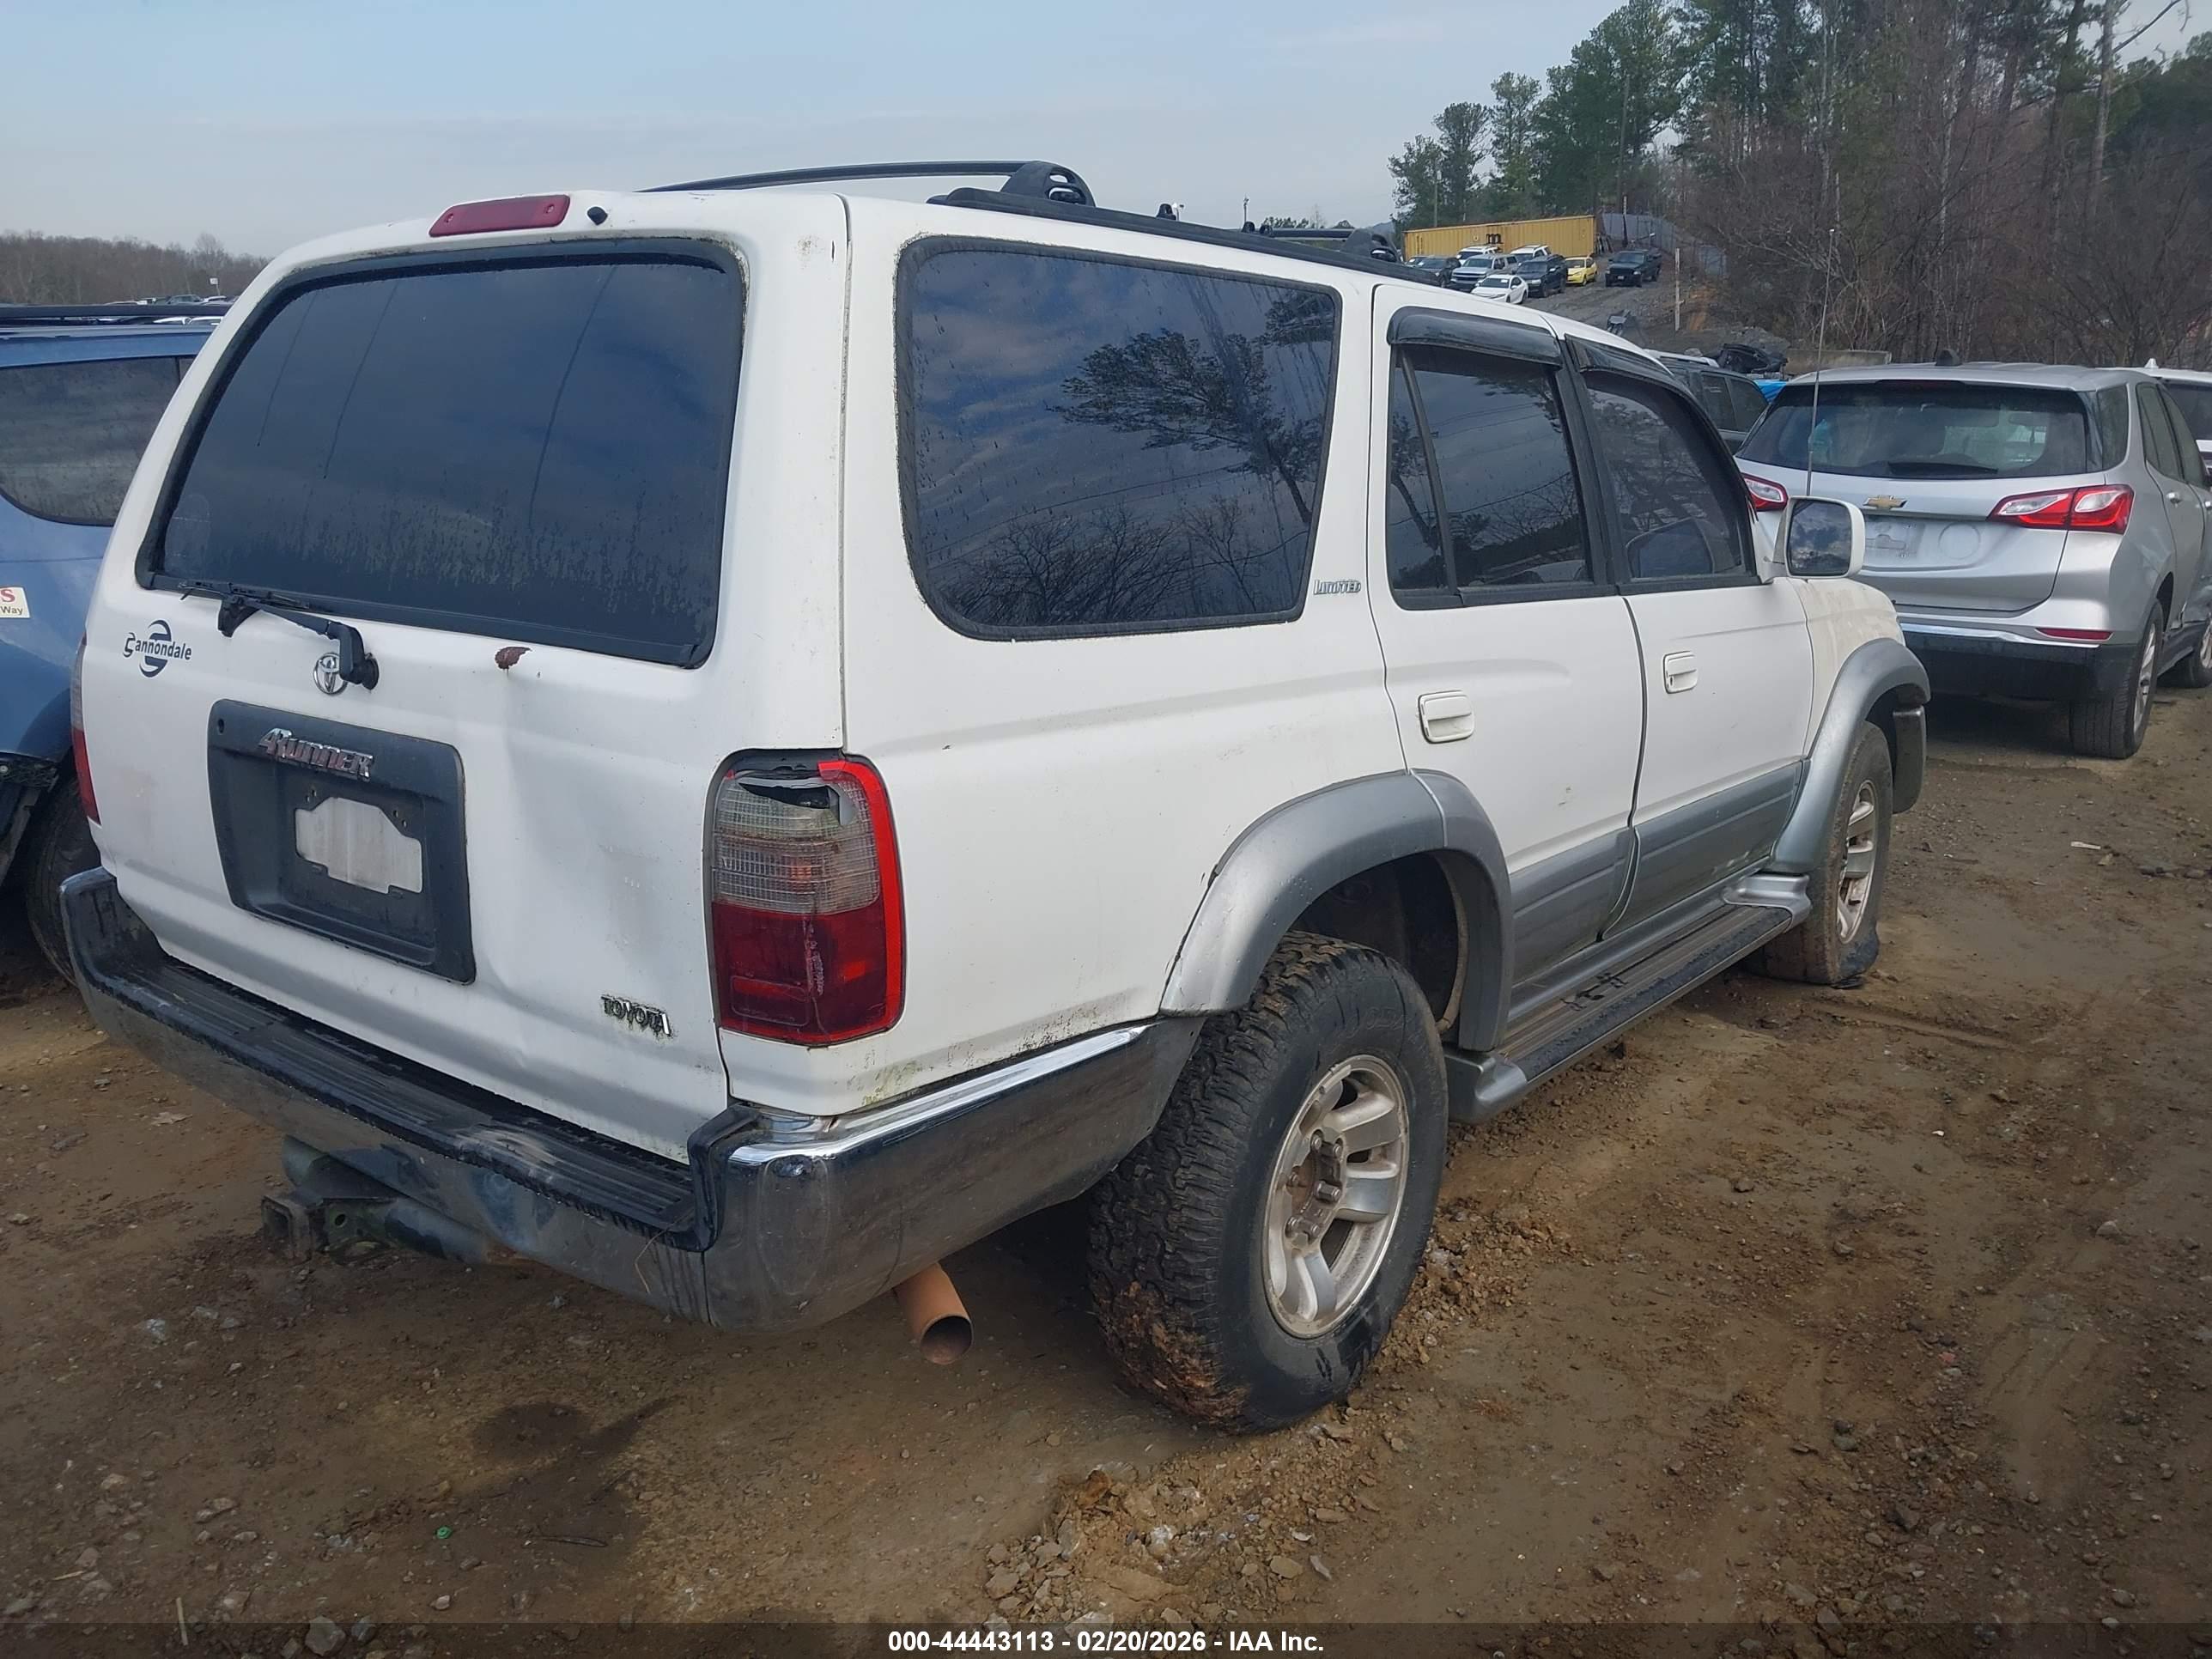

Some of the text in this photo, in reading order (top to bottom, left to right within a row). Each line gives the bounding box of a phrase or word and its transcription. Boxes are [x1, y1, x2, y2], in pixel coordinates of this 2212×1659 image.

[0, 605, 23, 616] Way
[123, 632, 192, 660] Cannondale
[600, 994, 672, 1037] TOYOTA
